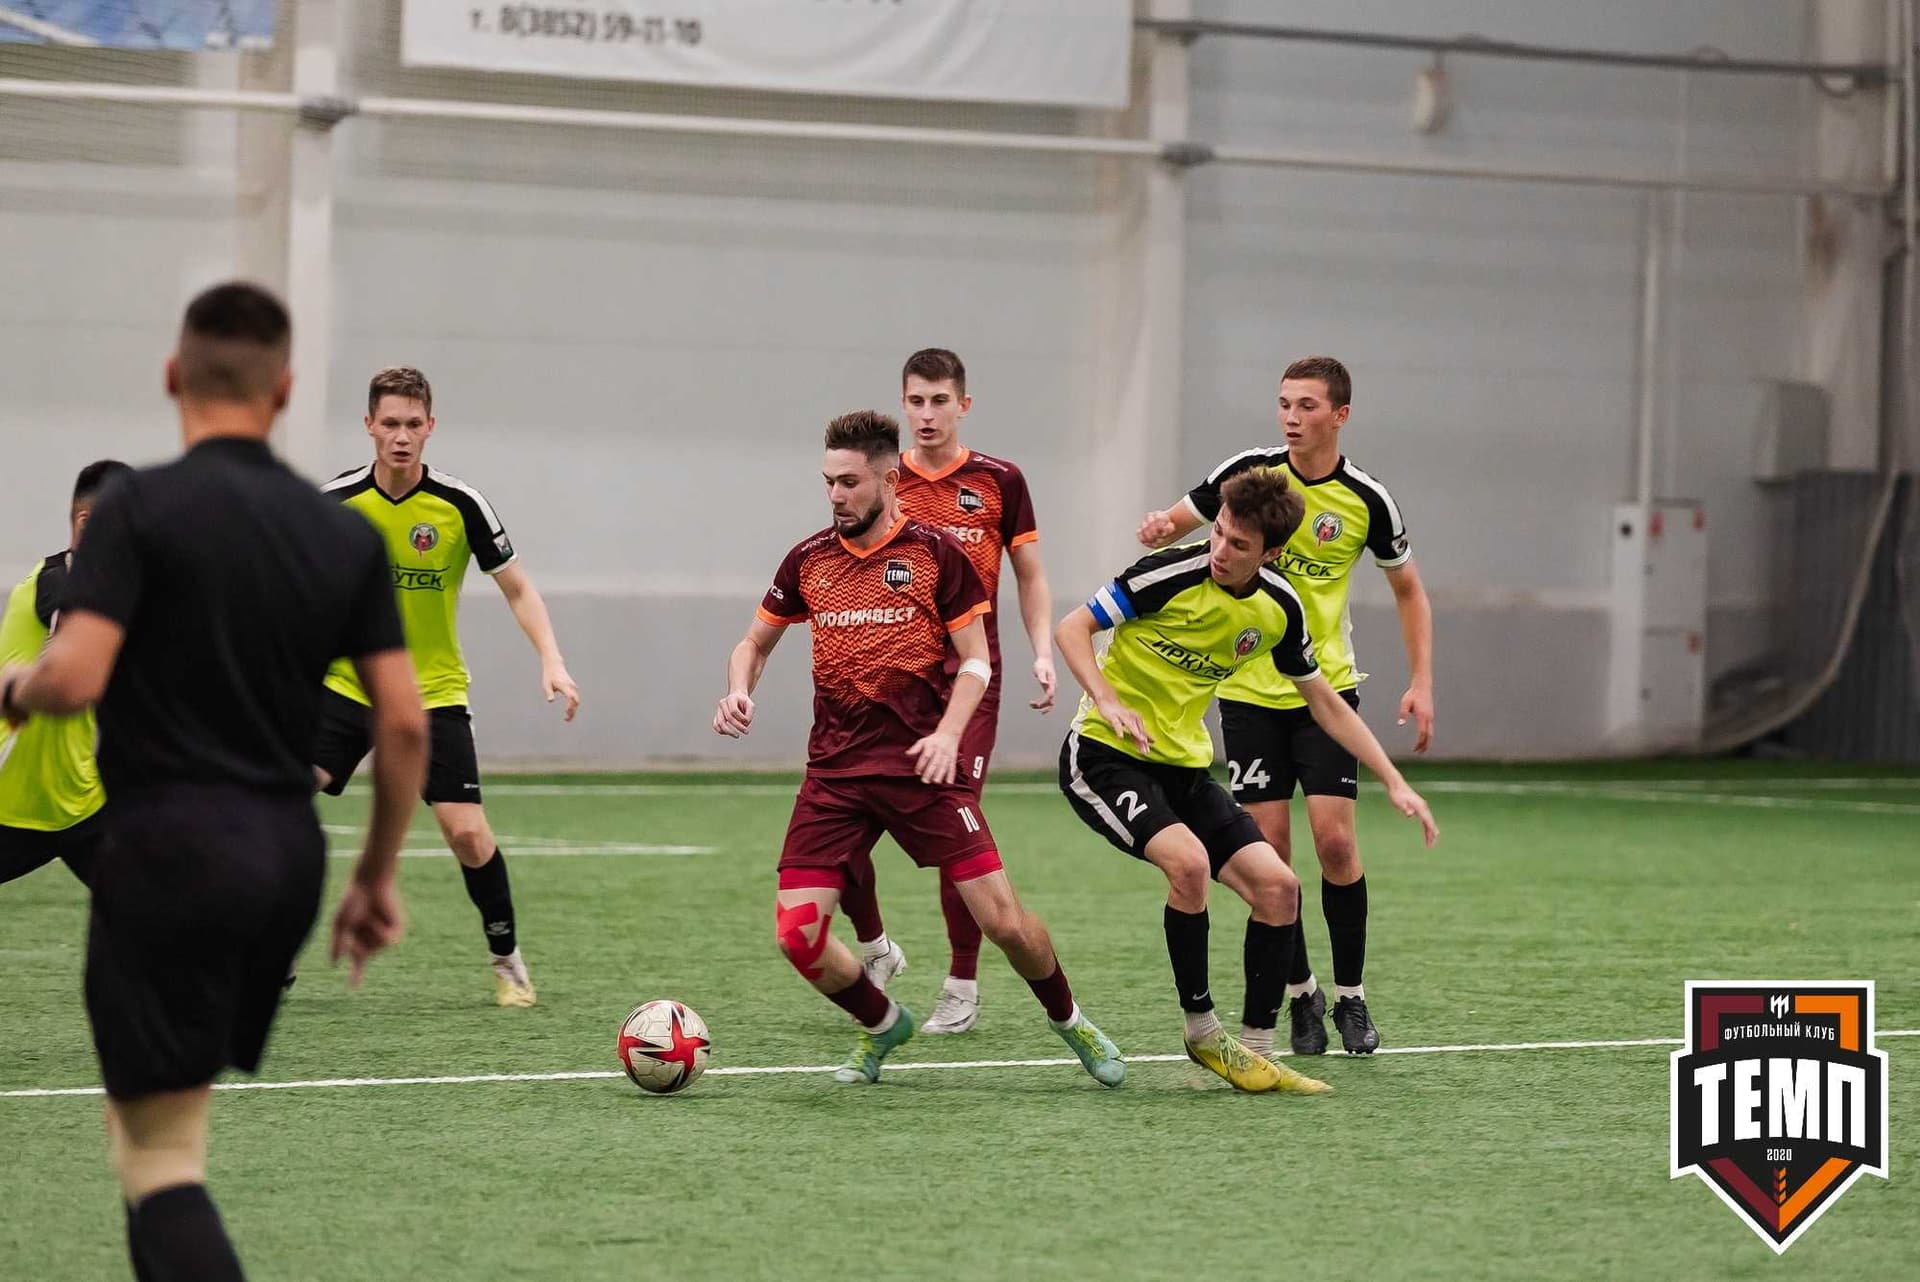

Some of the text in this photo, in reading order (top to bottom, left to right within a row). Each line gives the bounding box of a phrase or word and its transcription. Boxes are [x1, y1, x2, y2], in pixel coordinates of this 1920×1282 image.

[886, 569, 910, 583] ТЕМП
[1277, 554, 1331, 577] УТСК
[393, 570, 442, 588] УТСК
[973, 755, 984, 779] 9
[1228, 758, 1271, 791] 24
[1116, 790, 1148, 822] 2
[957, 806, 980, 833] 10
